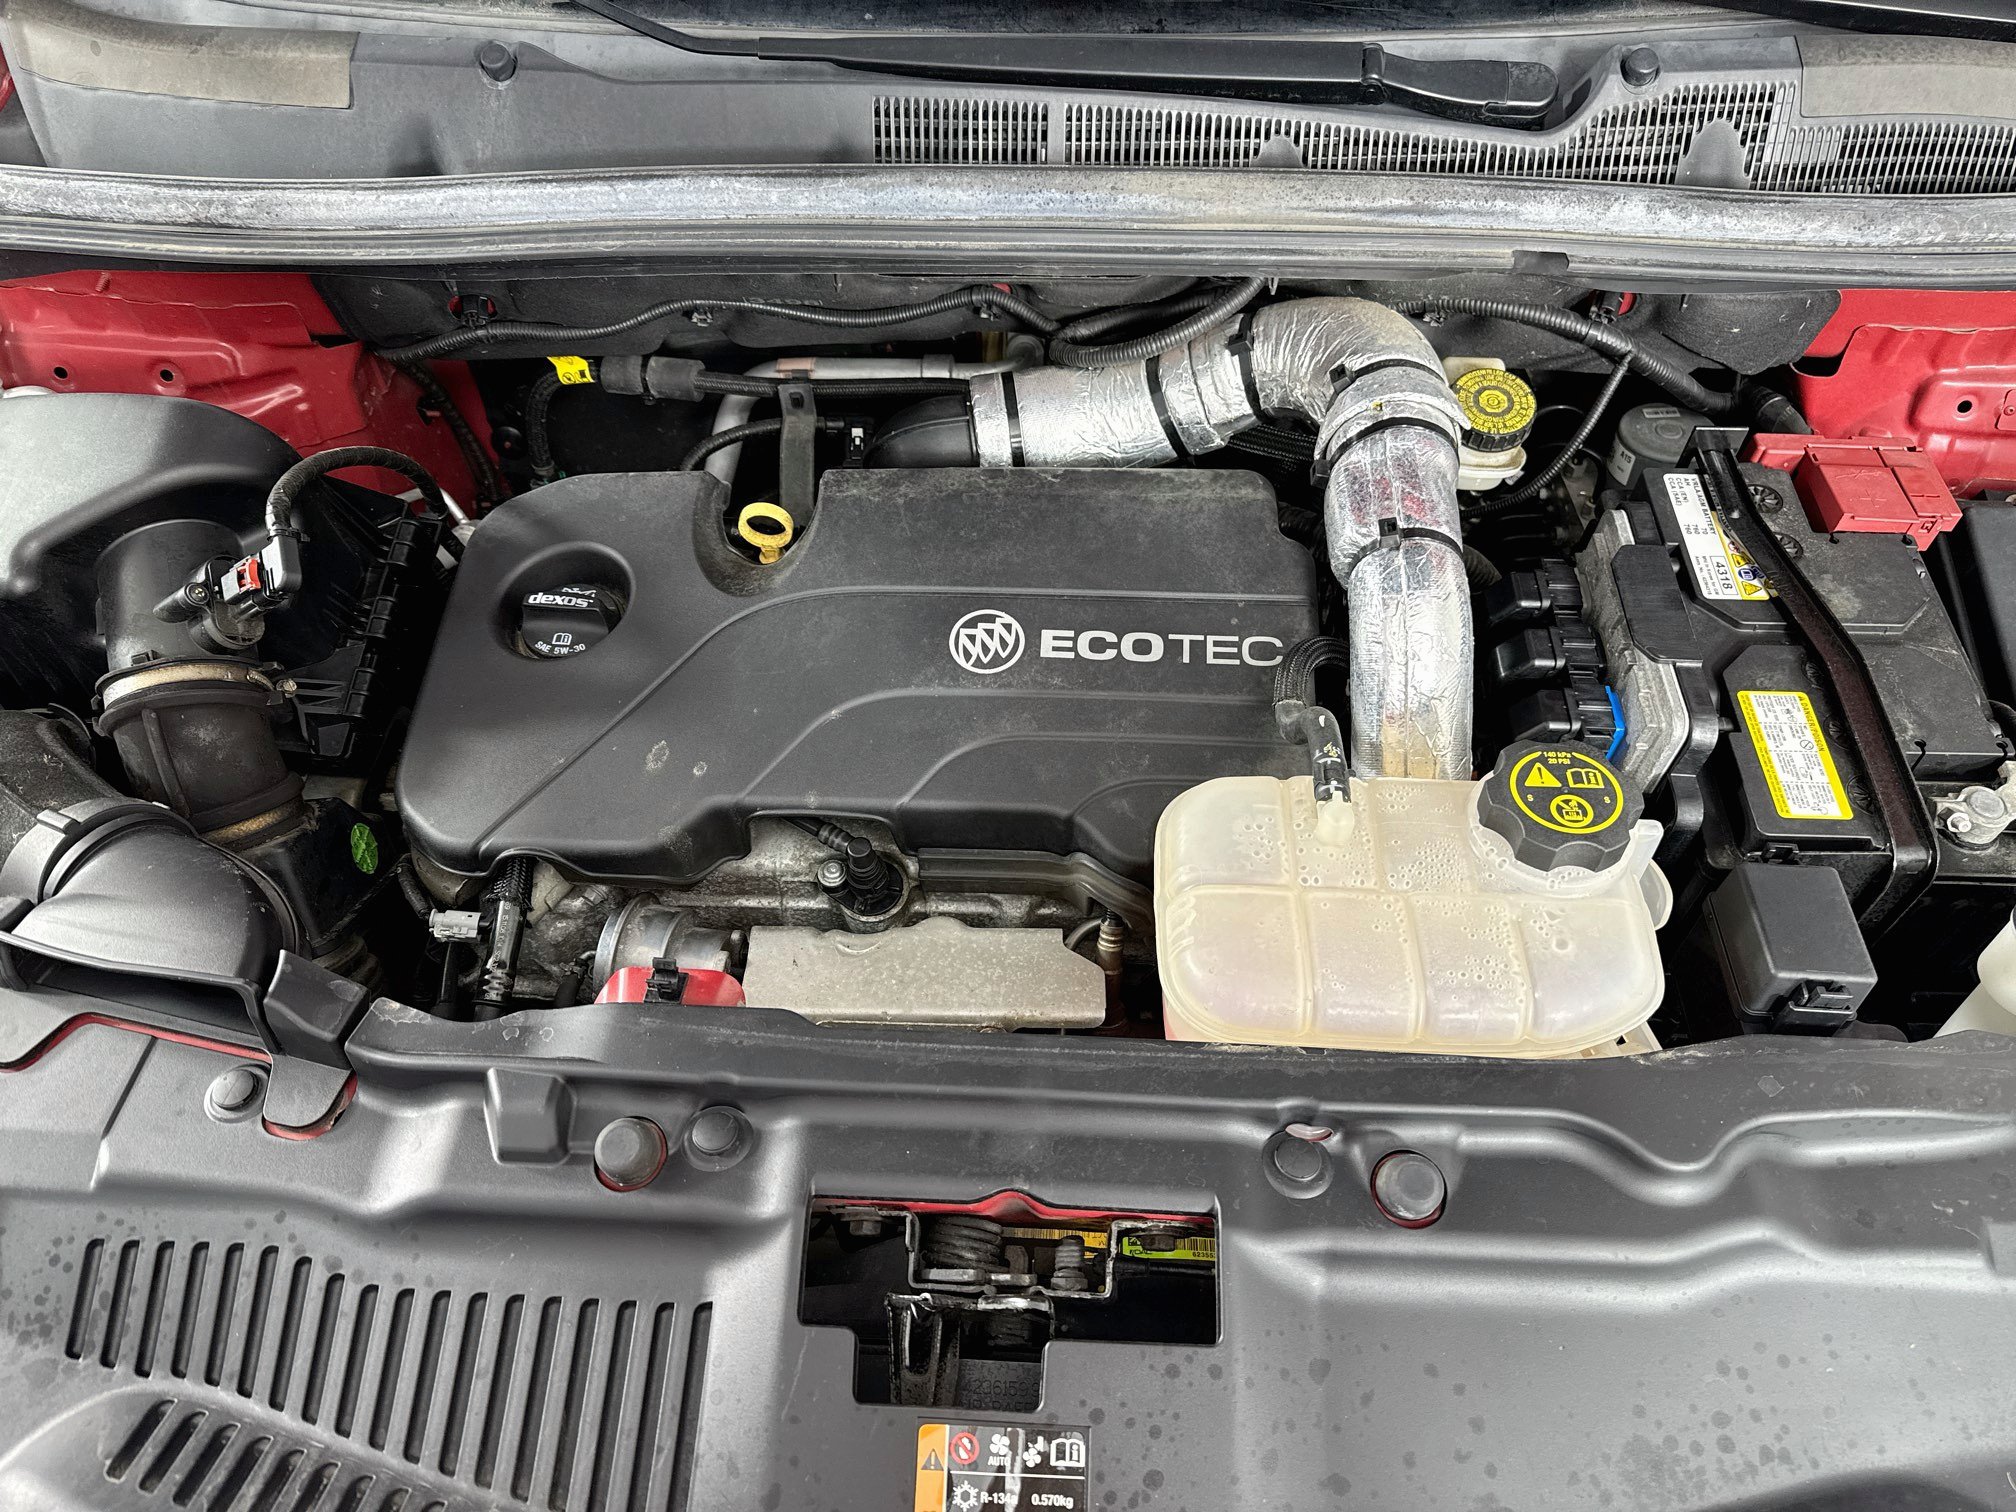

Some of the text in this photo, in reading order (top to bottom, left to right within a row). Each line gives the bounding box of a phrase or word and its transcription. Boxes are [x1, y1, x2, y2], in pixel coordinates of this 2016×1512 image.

[1701, 508, 1717, 535] BATTERY
[1713, 561, 1733, 589] 4318
[528, 592, 590, 608] dexos
[534, 640, 586, 655] SAE 5W-30
[1040, 629, 1284, 667] ECOTEC
[988, 1456, 1011, 1466] AUTO
[1031, 1493, 1074, 1510] 0.570kg
